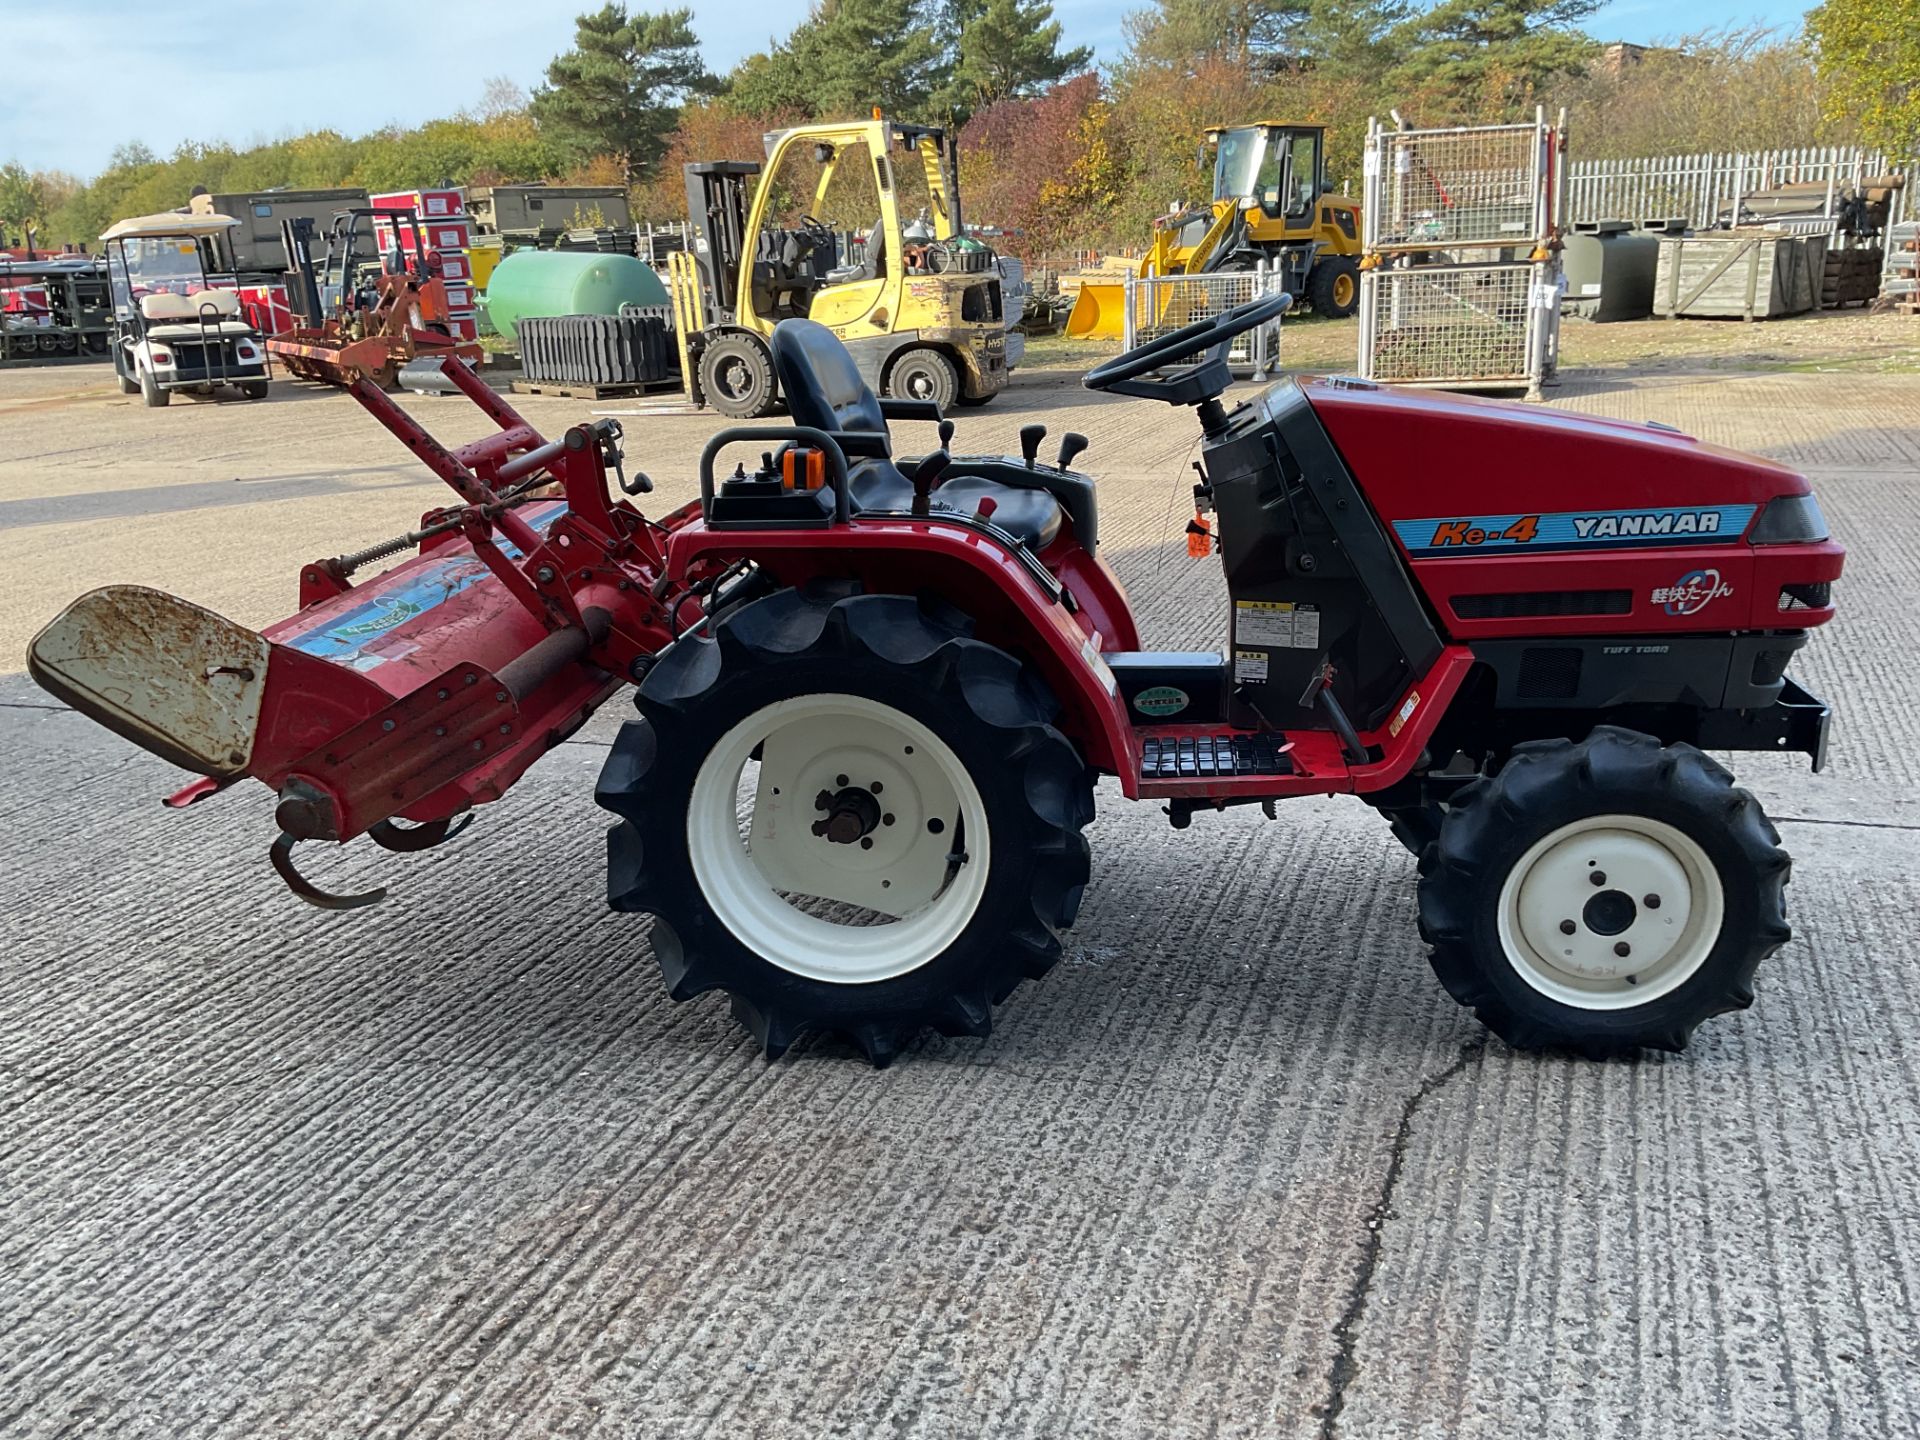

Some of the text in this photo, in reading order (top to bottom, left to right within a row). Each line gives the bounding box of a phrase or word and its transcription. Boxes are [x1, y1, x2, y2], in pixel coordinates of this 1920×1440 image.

[1429, 512, 1721, 546] Ke-4 YANMAR
[1603, 646, 1633, 654] TUFF
